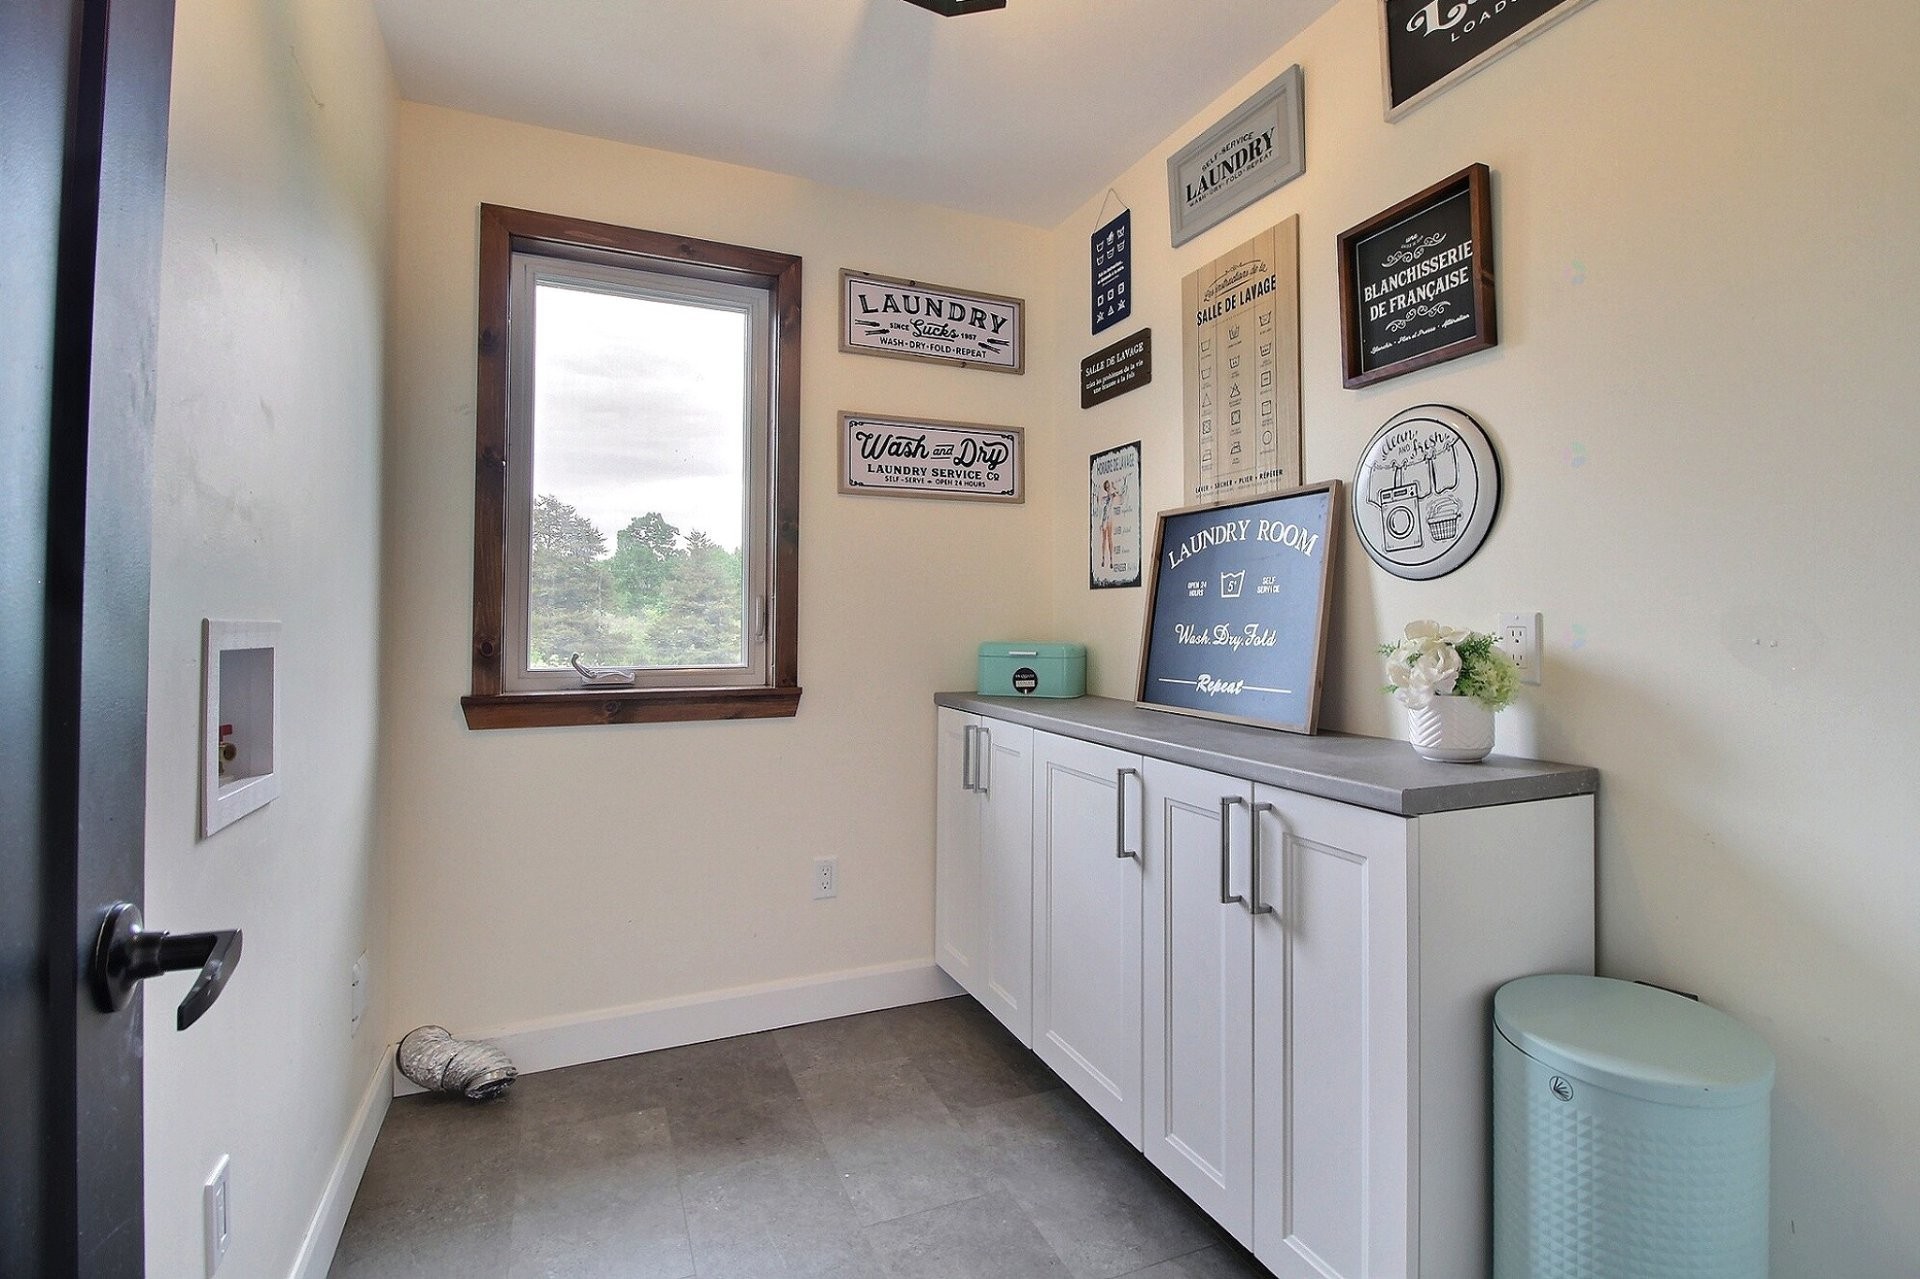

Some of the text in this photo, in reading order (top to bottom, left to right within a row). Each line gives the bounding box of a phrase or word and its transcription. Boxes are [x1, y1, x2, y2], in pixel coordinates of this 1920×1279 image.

[1450, 0, 1517, 42] LOAD
[1186, 127, 1275, 203] LAUNDRY
[1364, 240, 1473, 302] BLANCHISSERIE
[1196, 274, 1276, 327] SALLE DE LAVAGE
[1370, 266, 1469, 321] DE FRANÇAISE
[858, 294, 1008, 334] LAUNDRY
[889, 322, 910, 331] SINCE
[910, 318, 959, 342] Sucks
[880, 337, 986, 358] WASH DRY FOLD REPEAT
[1085, 341, 1144, 377] SALLE DE LAVAGE
[856, 431, 1009, 470] Wash and Dry
[1381, 430, 1415, 455] clean
[1412, 431, 1444, 456] fresh
[867, 463, 927, 477] LAUNDRY
[931, 468, 982, 480] SERVICE
[964, 480, 986, 488] HOURS
[1168, 519, 1319, 569] LAUNDRY ROOM
[1187, 580, 1207, 589] OPEN 24
[1256, 585, 1280, 594] SERVICE
[1262, 576, 1276, 585] SELF
[1195, 674, 1244, 696] Repeat
